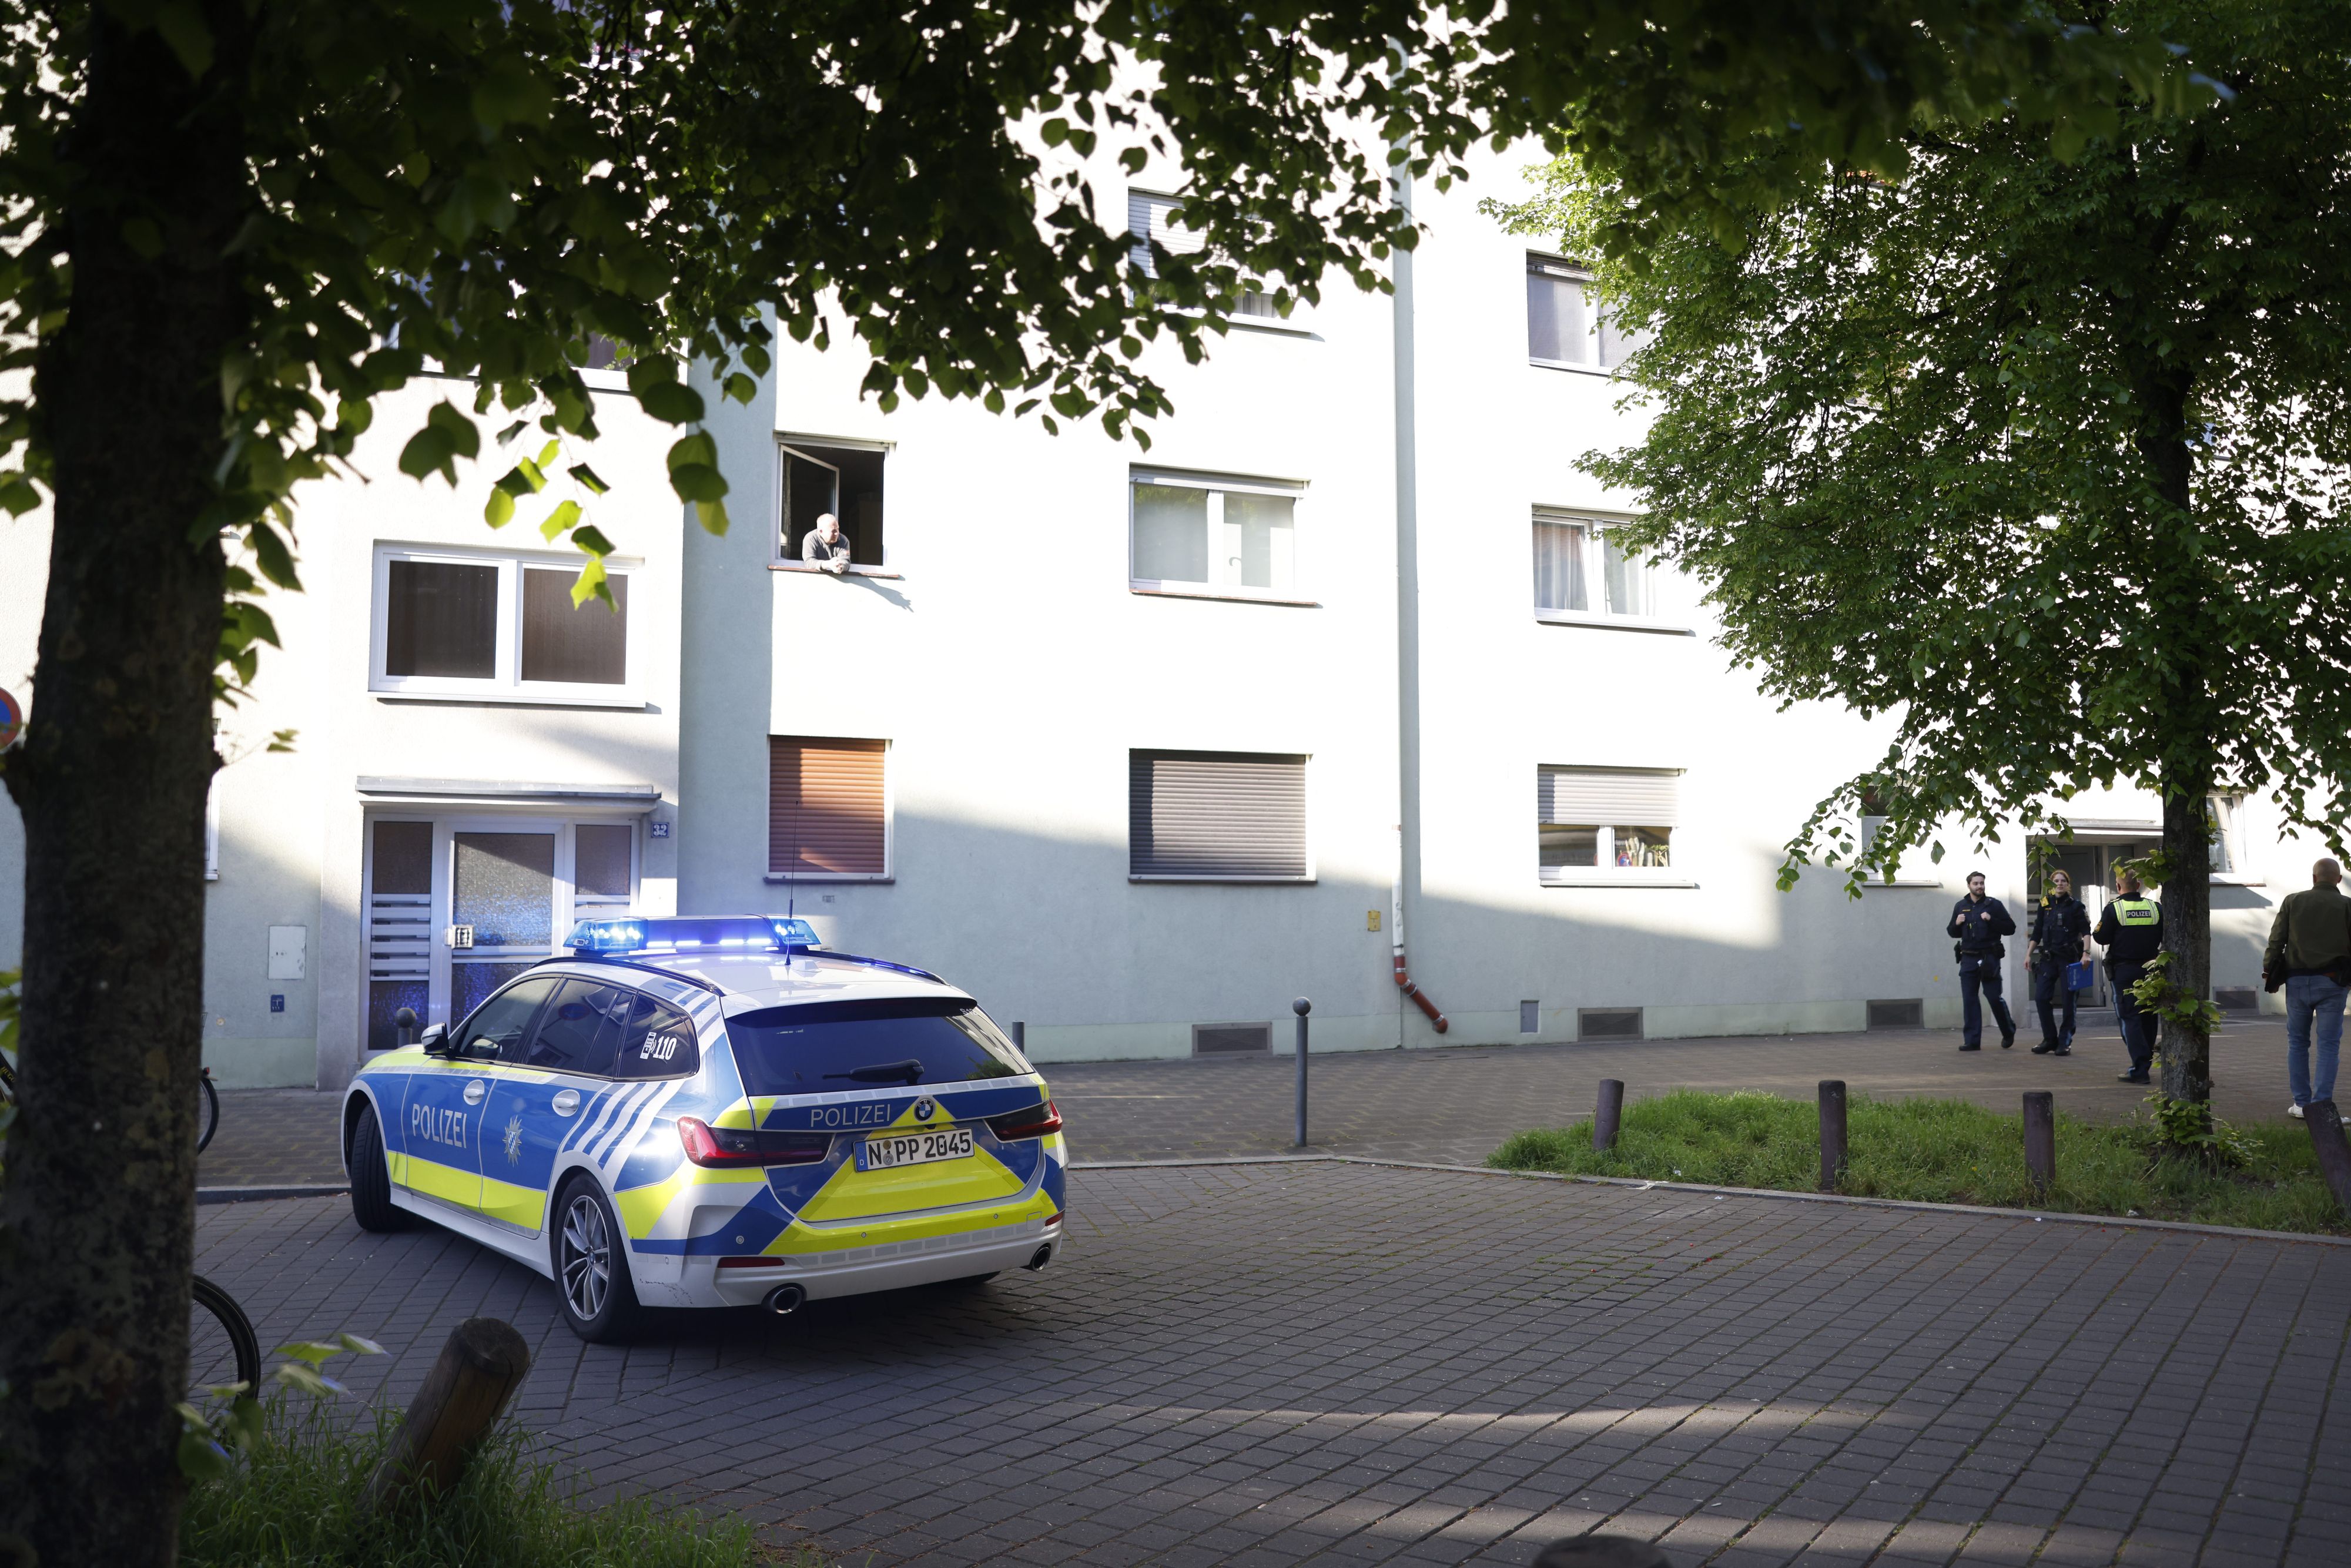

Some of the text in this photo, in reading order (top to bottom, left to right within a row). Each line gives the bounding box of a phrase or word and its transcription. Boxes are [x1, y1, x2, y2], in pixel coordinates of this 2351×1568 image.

[654, 825, 667, 836] 32
[653, 1036, 677, 1060] 110
[412, 1103, 467, 1149] POLIZEI
[811, 1104, 890, 1127] POLIZEI
[868, 1143, 882, 1165] N
[894, 1138, 920, 1162] PP
[924, 1131, 971, 1158] 2045
